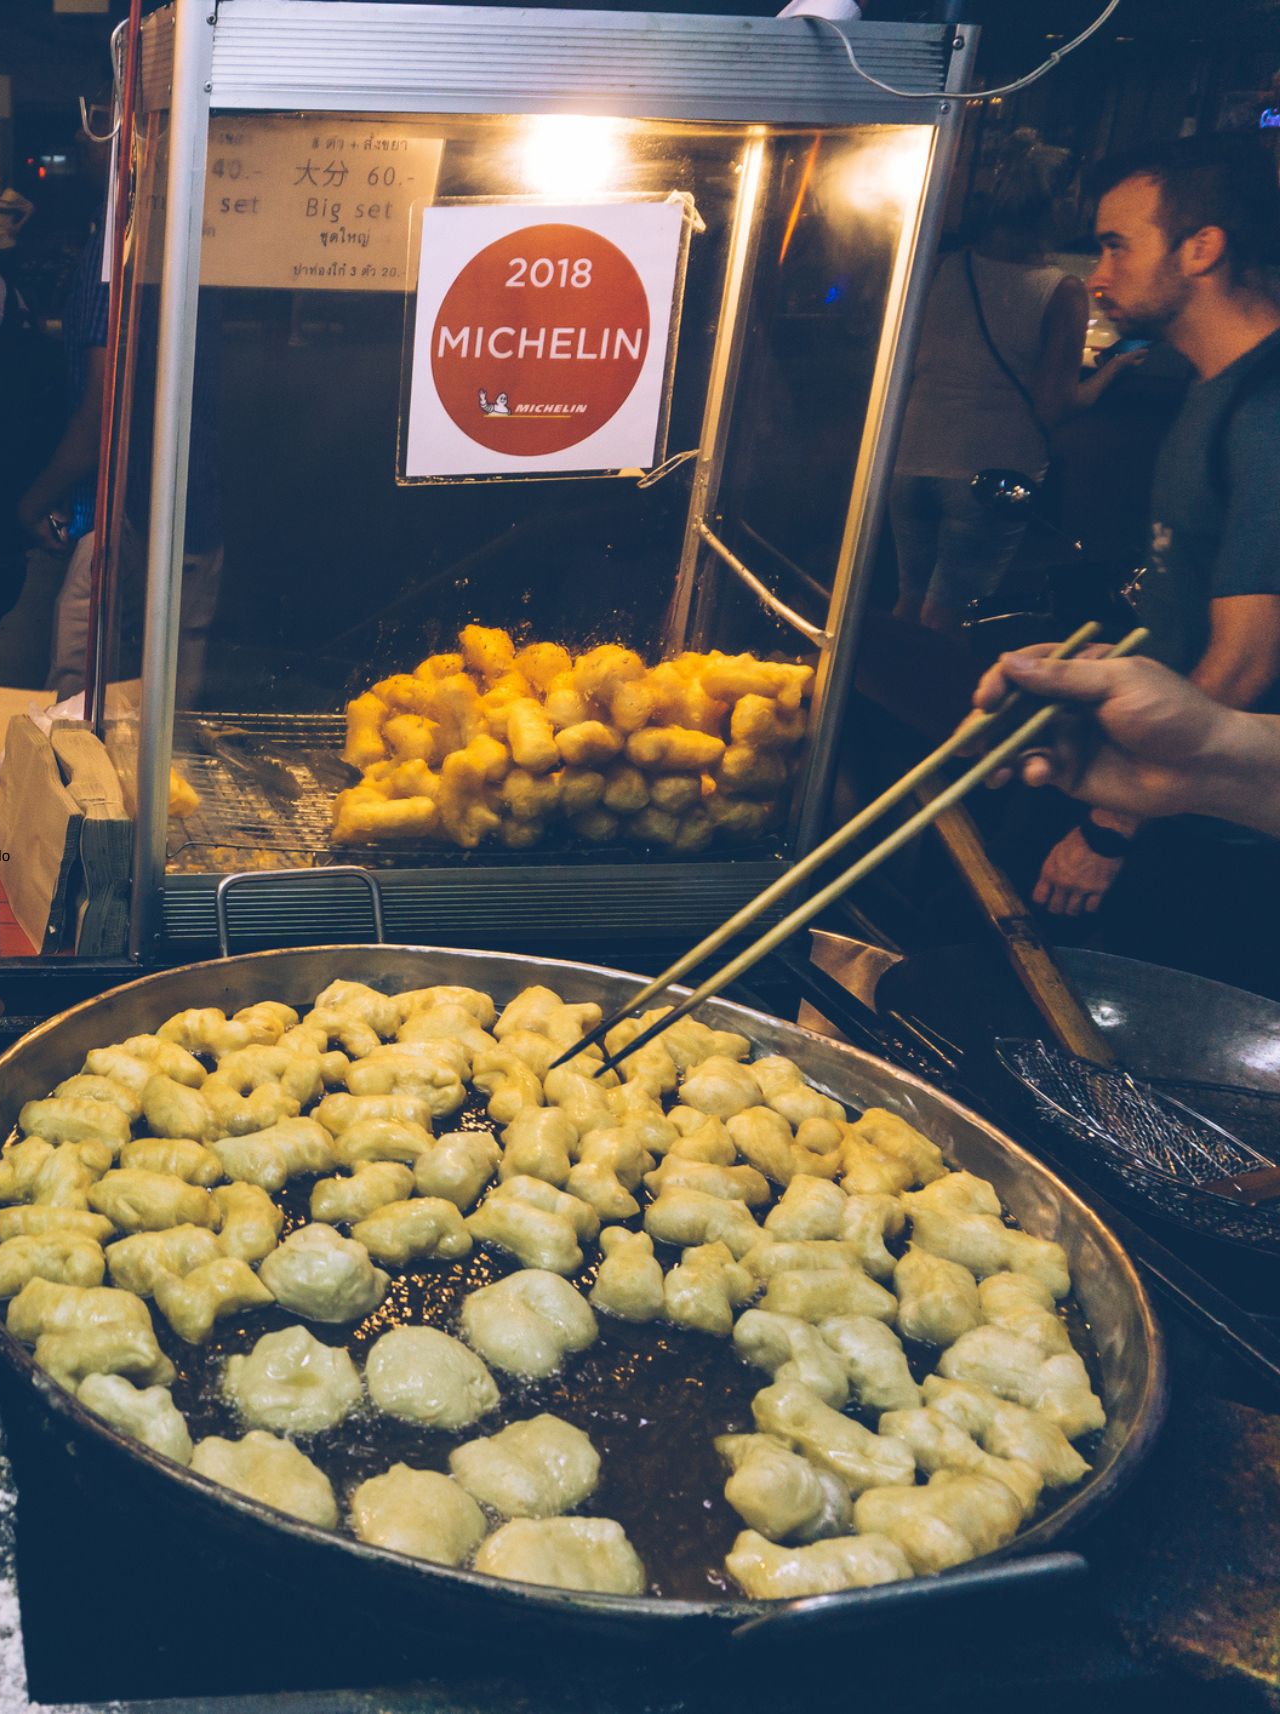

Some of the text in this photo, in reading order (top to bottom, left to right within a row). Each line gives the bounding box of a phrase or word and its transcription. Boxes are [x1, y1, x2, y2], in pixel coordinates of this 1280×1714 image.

[293, 158, 415, 187] 大分 60.-
[220, 195, 259, 213] set
[306, 197, 393, 223] Big set
[505, 257, 592, 288] 2018
[437, 326, 643, 360] MICHELIN
[514, 404, 587, 413] MICHELIN
